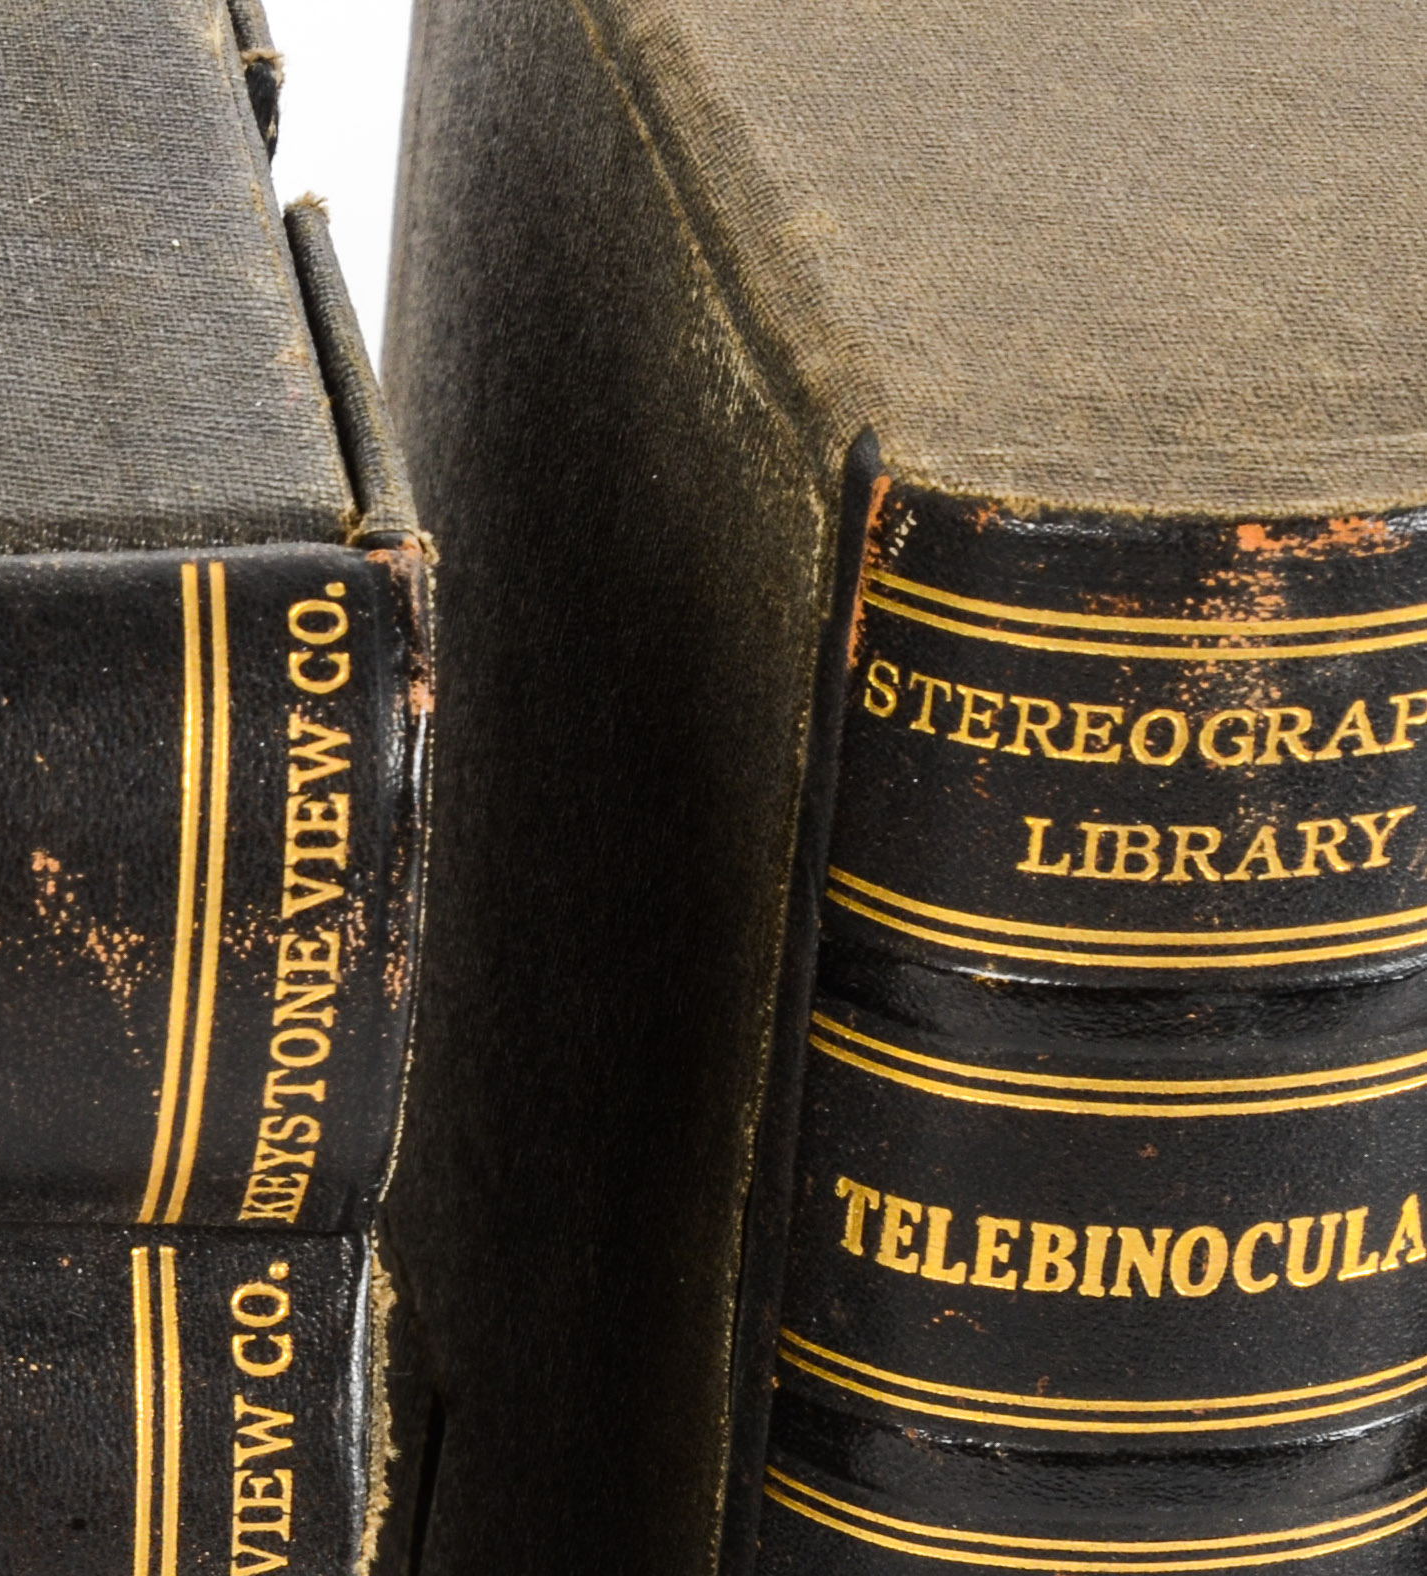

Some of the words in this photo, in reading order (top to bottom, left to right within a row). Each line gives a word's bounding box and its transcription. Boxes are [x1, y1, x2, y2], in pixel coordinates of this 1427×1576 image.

[287, 580, 351, 695] CO.
[862, 658, 1427, 767] STEREOGRAP
[281, 712, 352, 919] VIEW
[1015, 804, 1419, 884] LIBRARY
[238, 929, 340, 1224] KEYSTONE
[834, 1175, 1427, 1300] TELEBINOCULA
[229, 1259, 293, 1378] CO.
